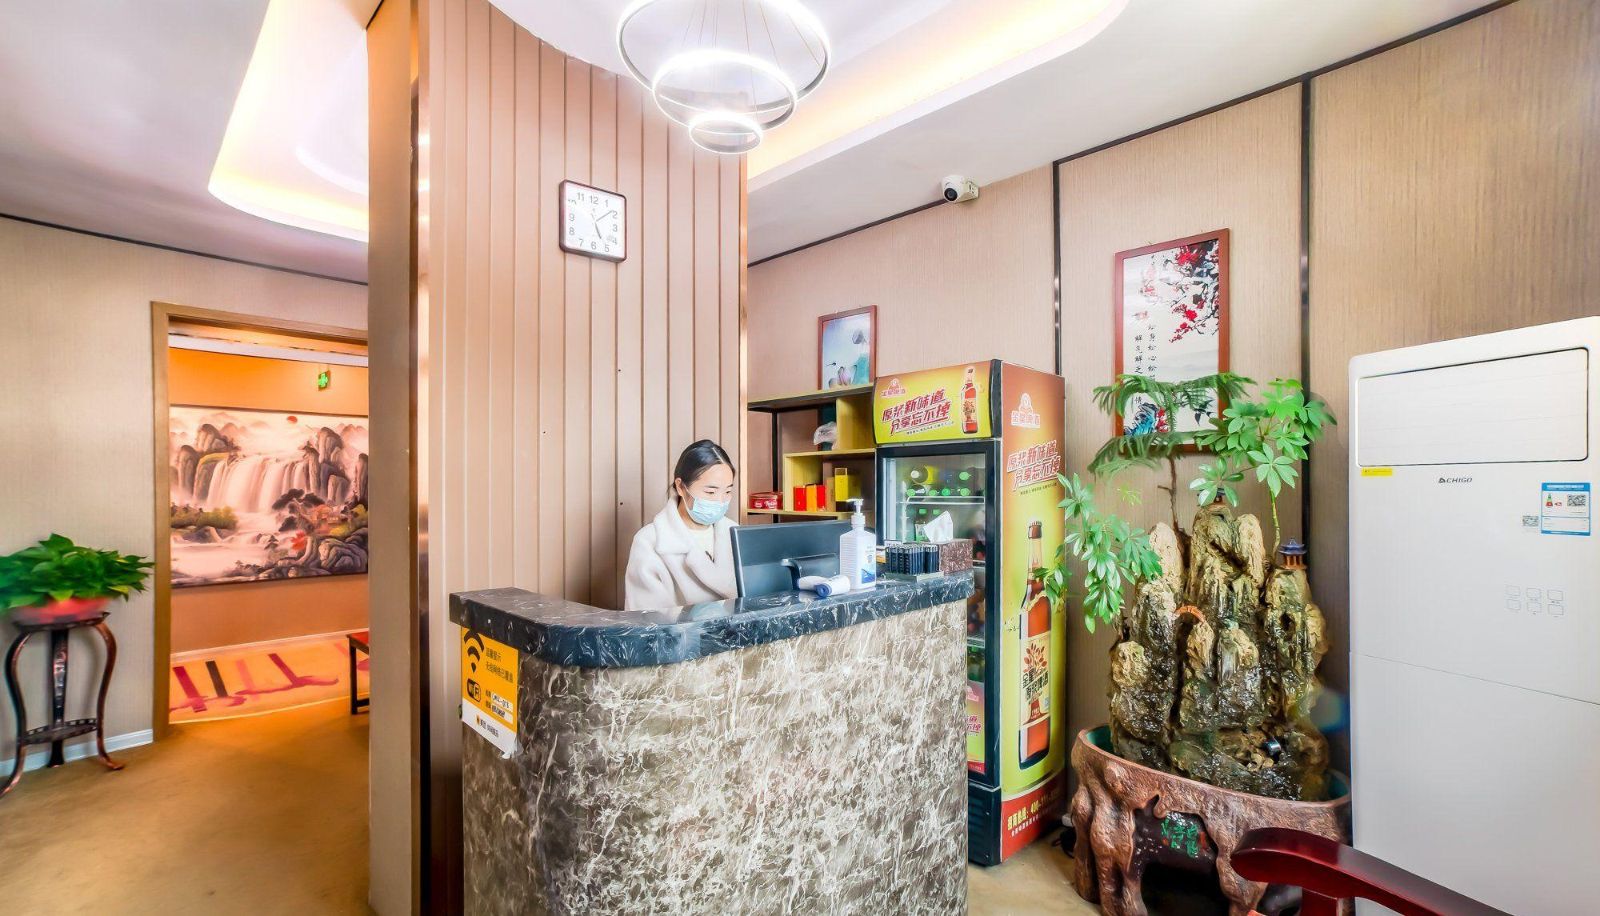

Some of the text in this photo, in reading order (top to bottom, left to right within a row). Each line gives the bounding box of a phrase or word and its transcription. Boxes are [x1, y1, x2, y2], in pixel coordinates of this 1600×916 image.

[589, 195, 599, 205] 12
[569, 213, 575, 222] 9
[612, 210, 618, 219] 2
[569, 227, 575, 236] 8
[612, 224, 618, 232] 3
[579, 238, 584, 247] 7
[590, 241, 597, 250] 6
[604, 243, 610, 253] 5
[882, 388, 946, 422] 原浆新味道
[890, 400, 951, 436] 分享忘不掉
[1008, 440, 1057, 472] 原浆新味道
